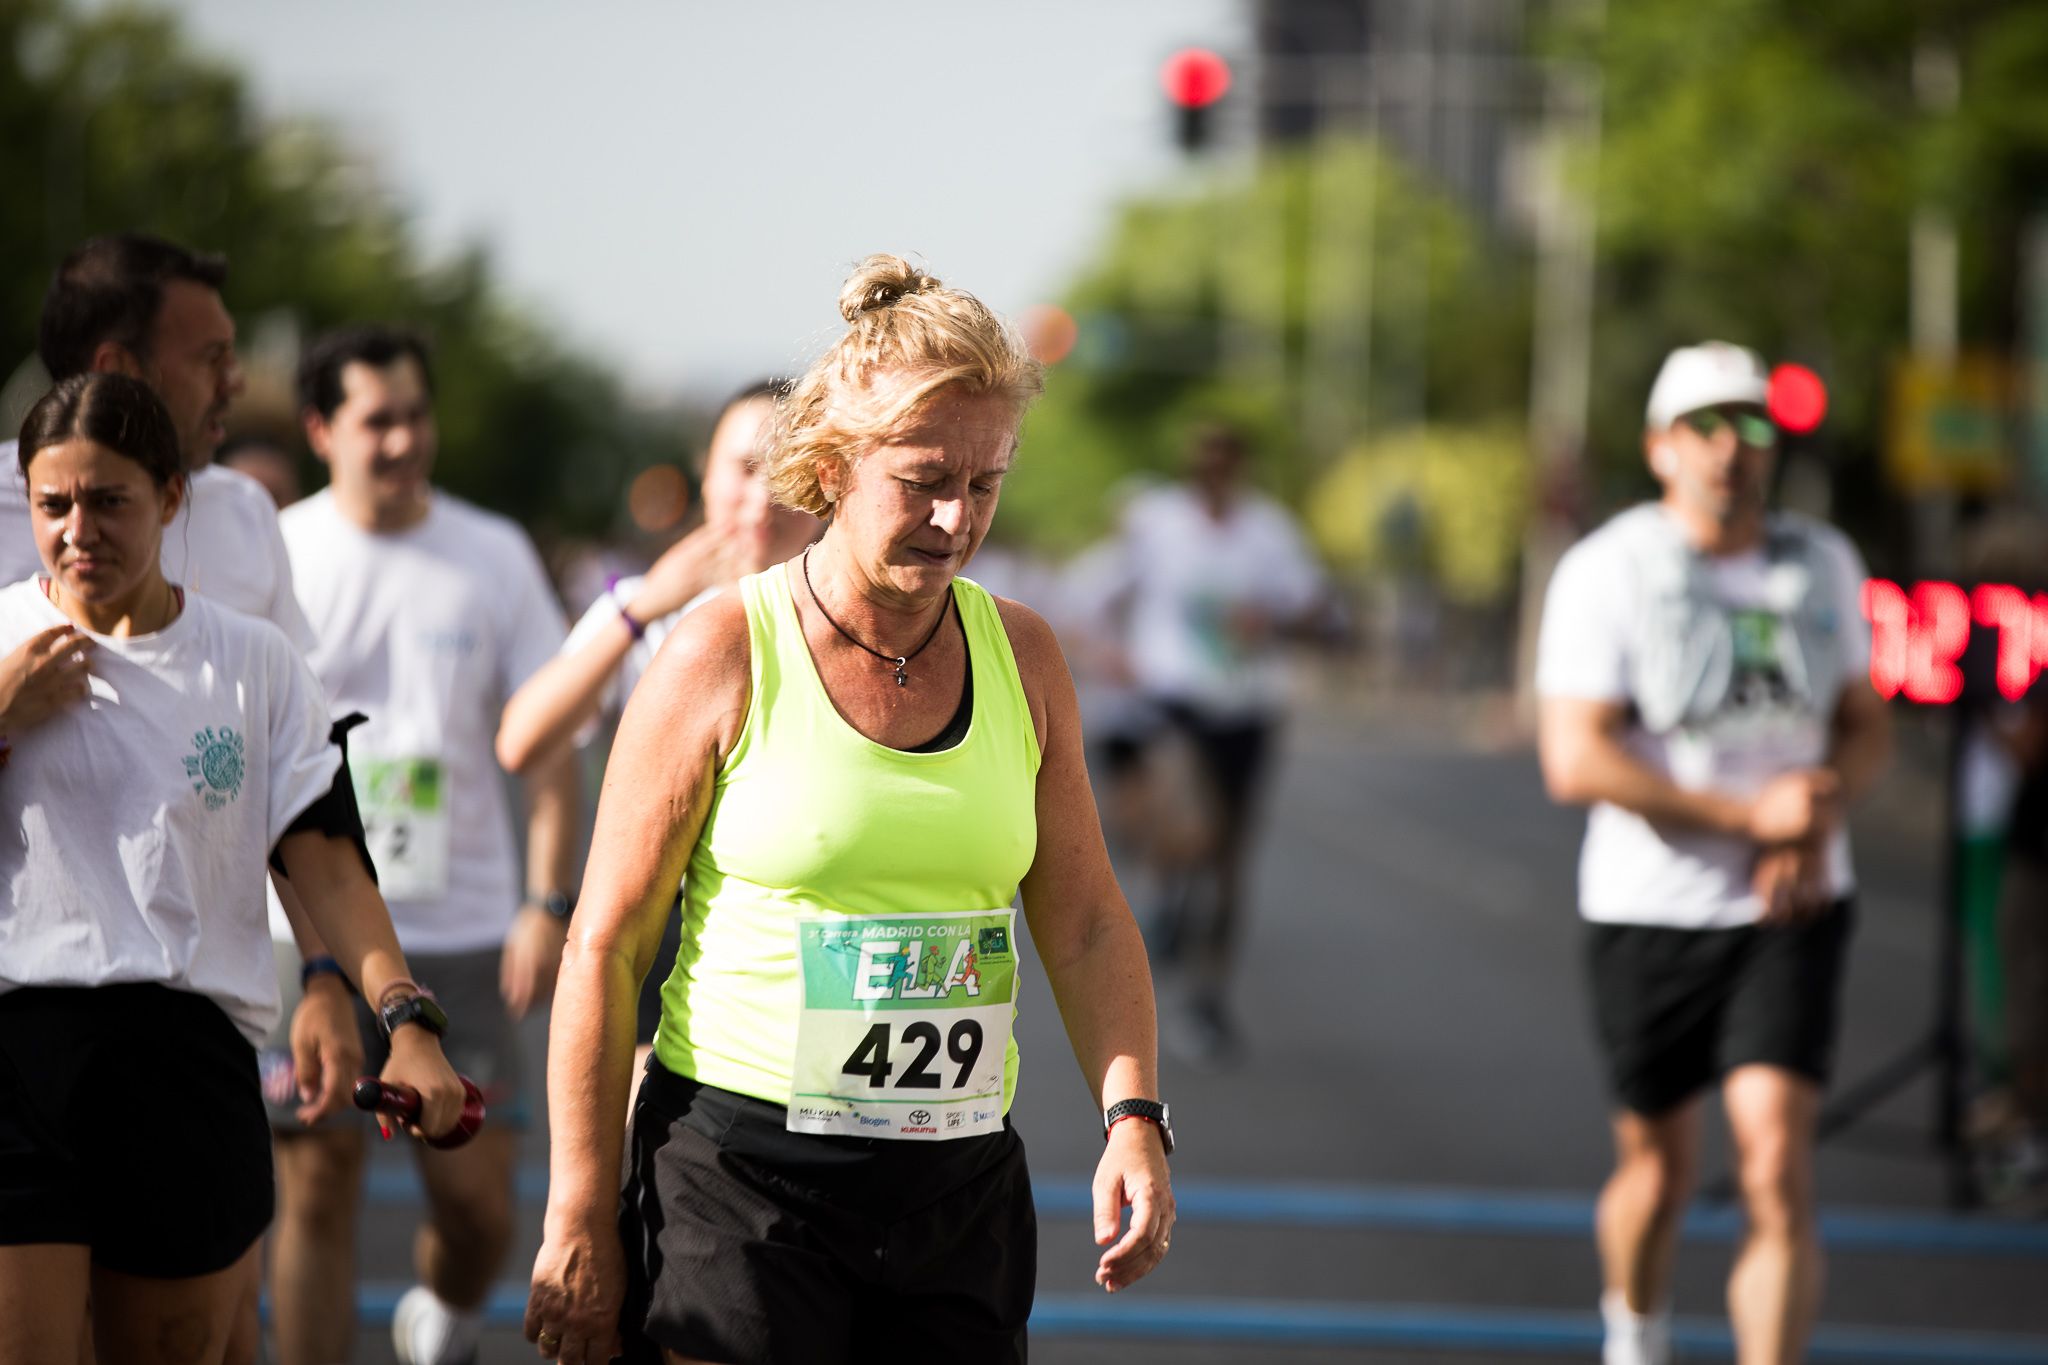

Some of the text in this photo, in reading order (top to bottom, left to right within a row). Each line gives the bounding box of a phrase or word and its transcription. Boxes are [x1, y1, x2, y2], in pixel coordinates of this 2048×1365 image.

[863, 925, 923, 939] MADRID
[927, 924, 956, 937] CON
[958, 924, 971, 936] LA
[852, 939, 982, 1001] ELA
[842, 1019, 984, 1090] 429
[859, 1115, 890, 1128] Biogen
